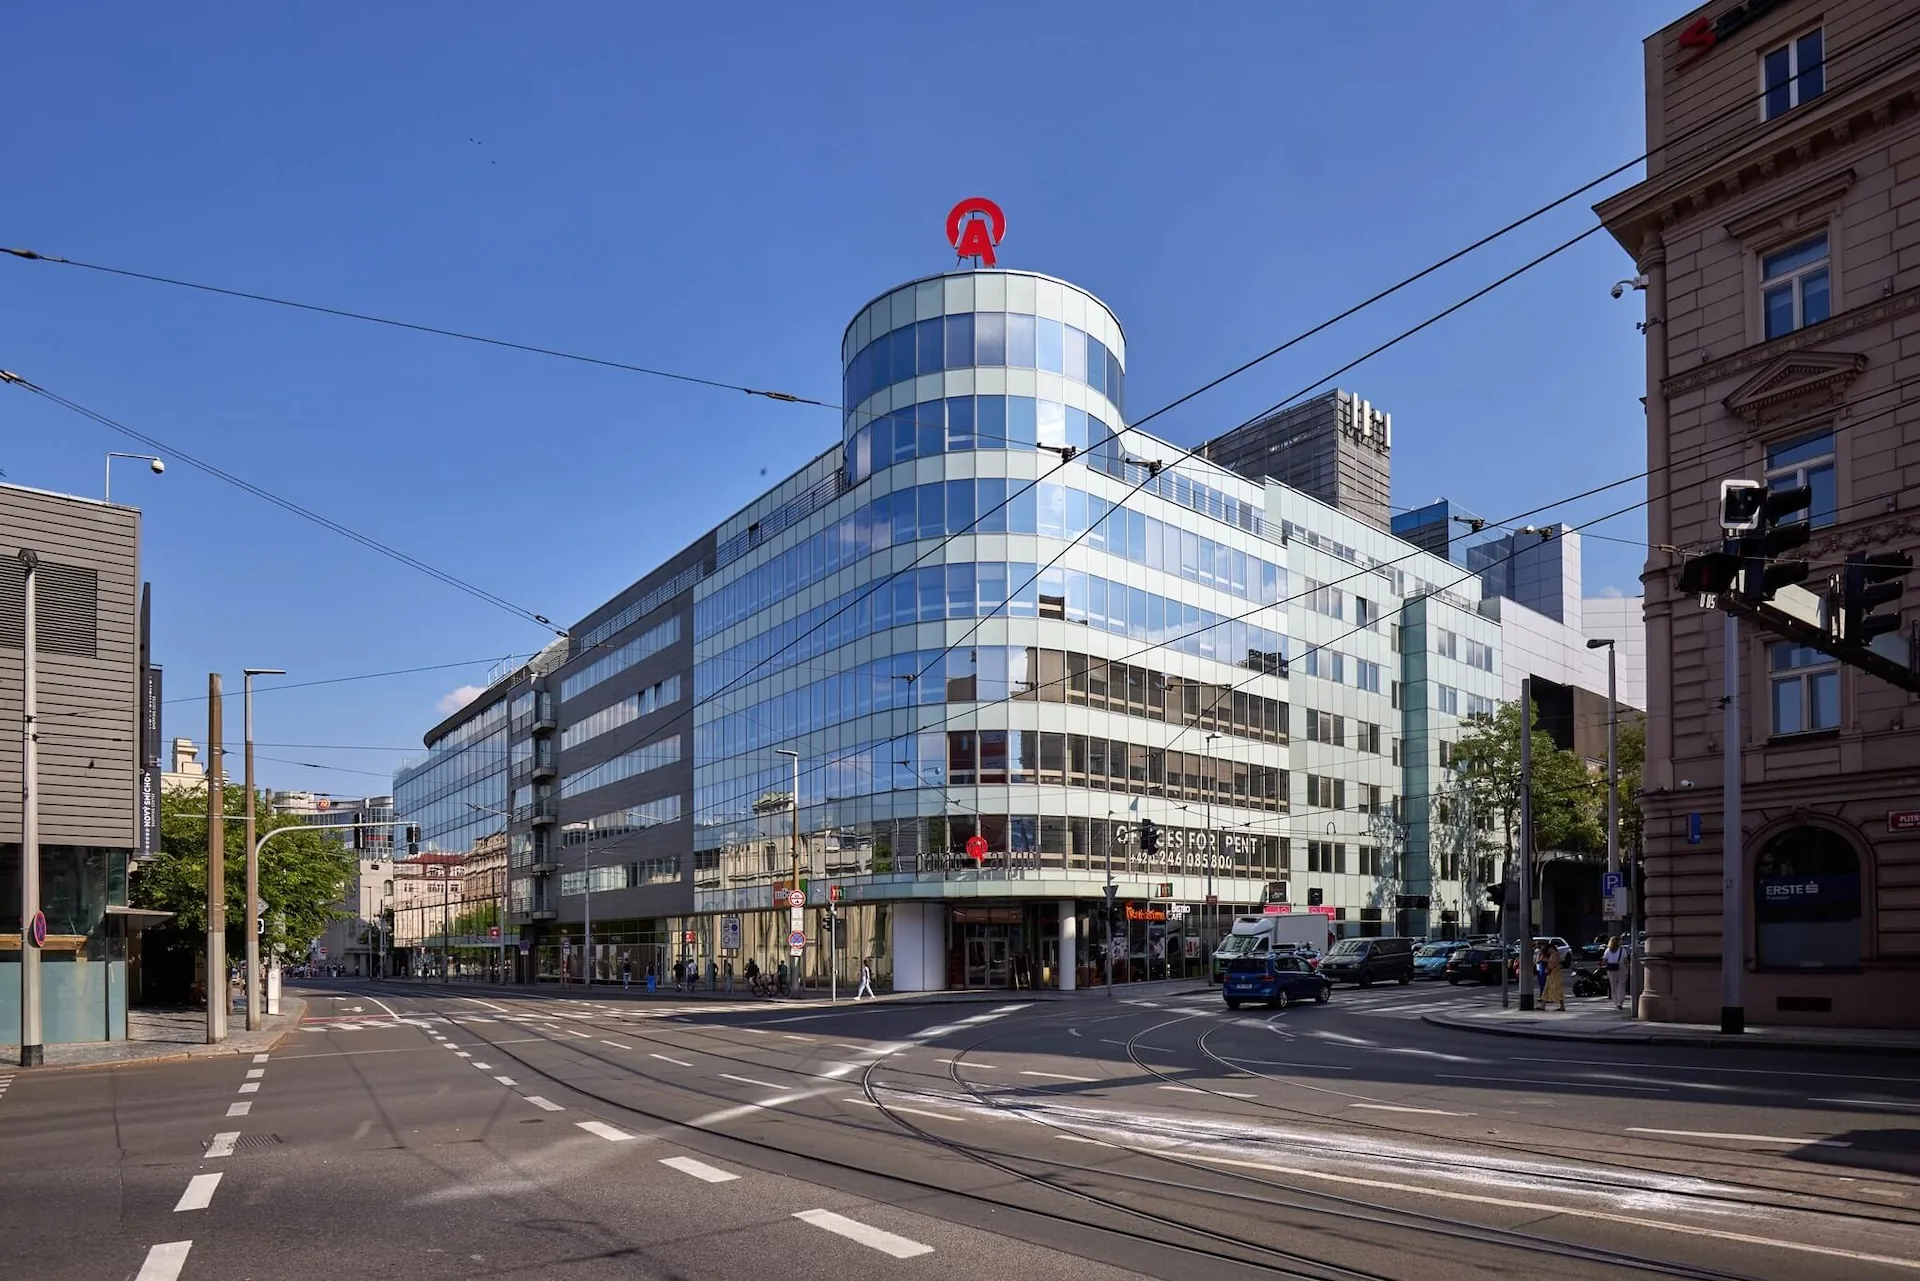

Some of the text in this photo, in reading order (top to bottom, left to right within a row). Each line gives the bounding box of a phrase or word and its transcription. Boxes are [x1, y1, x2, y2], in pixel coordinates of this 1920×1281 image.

[1116, 825, 1183, 848] OFCES
[1188, 832, 1216, 851] FOR
[1159, 850, 1182, 866] 246
[1765, 884, 1804, 895] ERSTE
